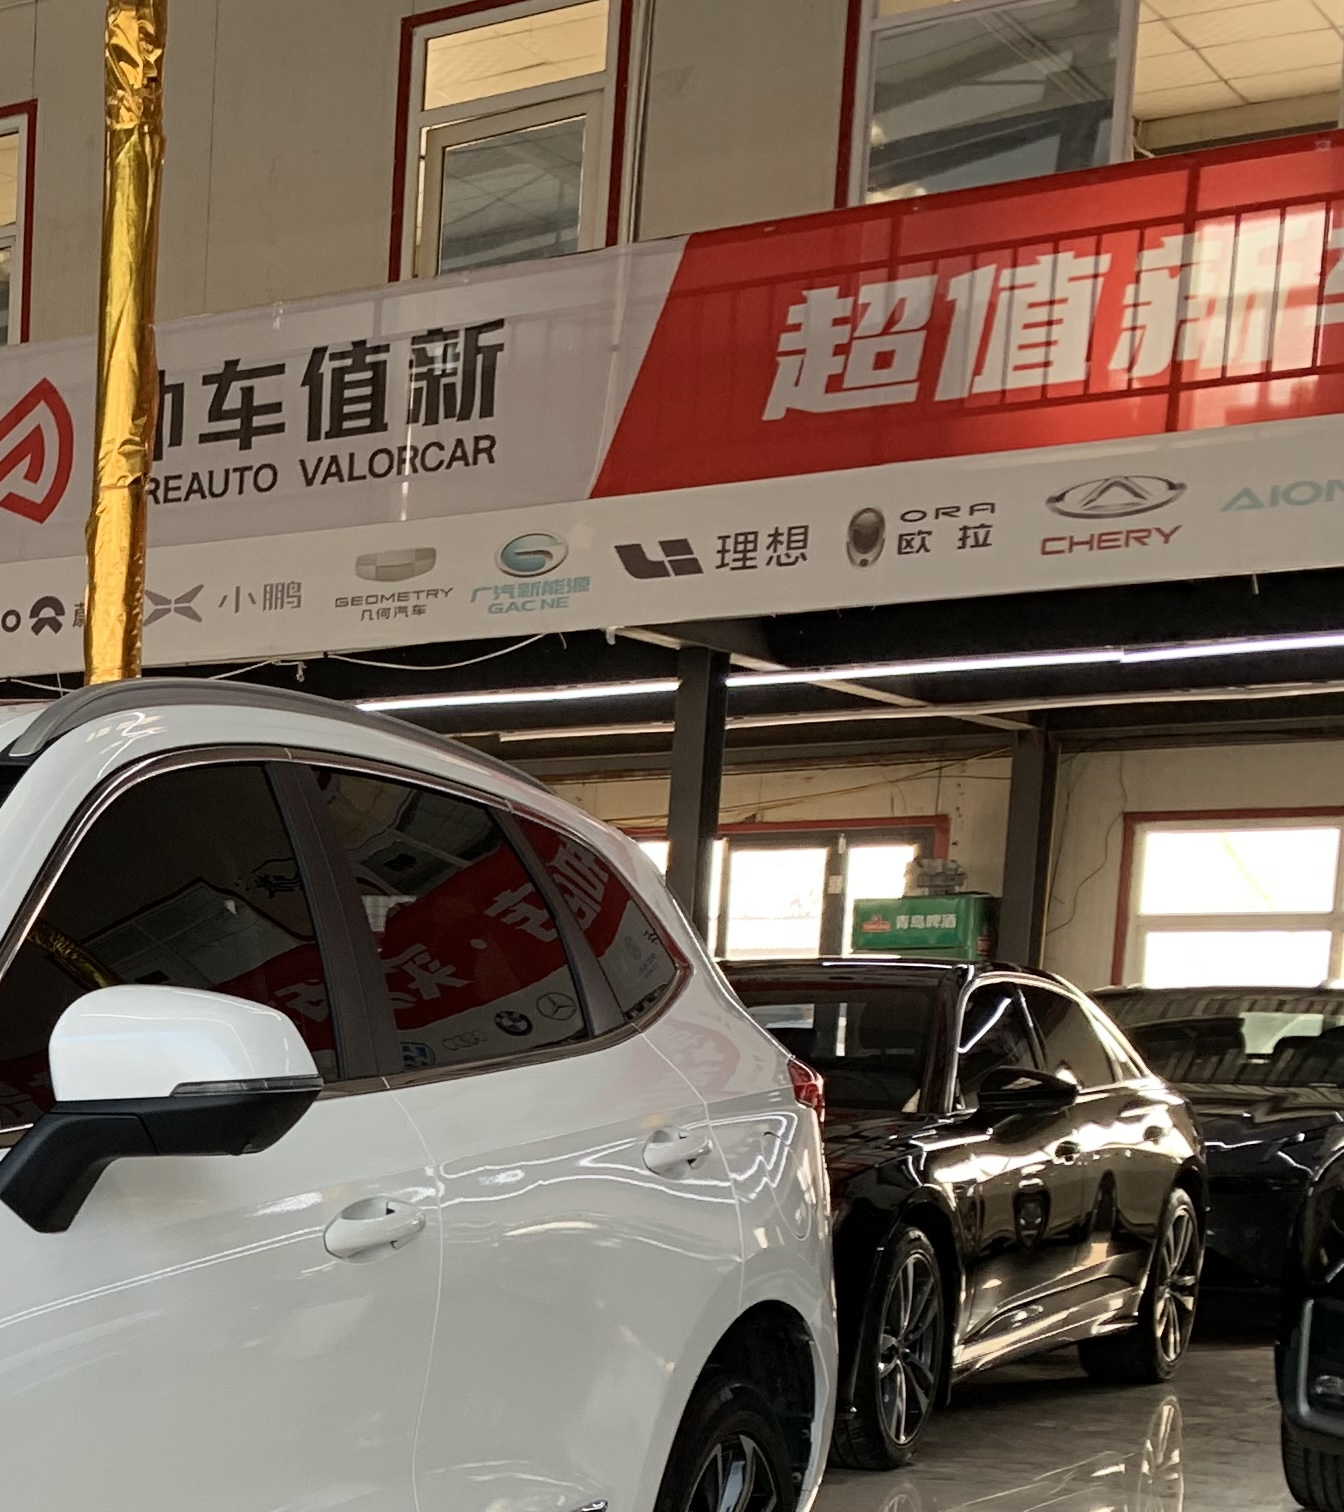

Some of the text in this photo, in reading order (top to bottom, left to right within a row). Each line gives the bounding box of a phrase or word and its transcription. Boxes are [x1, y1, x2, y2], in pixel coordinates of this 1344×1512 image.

[762, 226, 1343, 420] 超值新
[298, 433, 497, 488] VALORCAR
[899, 501, 997, 523] ORA
[714, 524, 810, 571] 理想
[897, 523, 994, 555] 欧拉
[1040, 525, 1183, 556] CHERY
[218, 581, 302, 613] 小鹏
[334, 586, 455, 609] GEOMETRY
[470, 576, 591, 603] 广汽新能源
[360, 603, 428, 622] 几何汽车
[487, 596, 570, 616] GAC NE
[896, 914, 957, 929] 青岛啤酒
